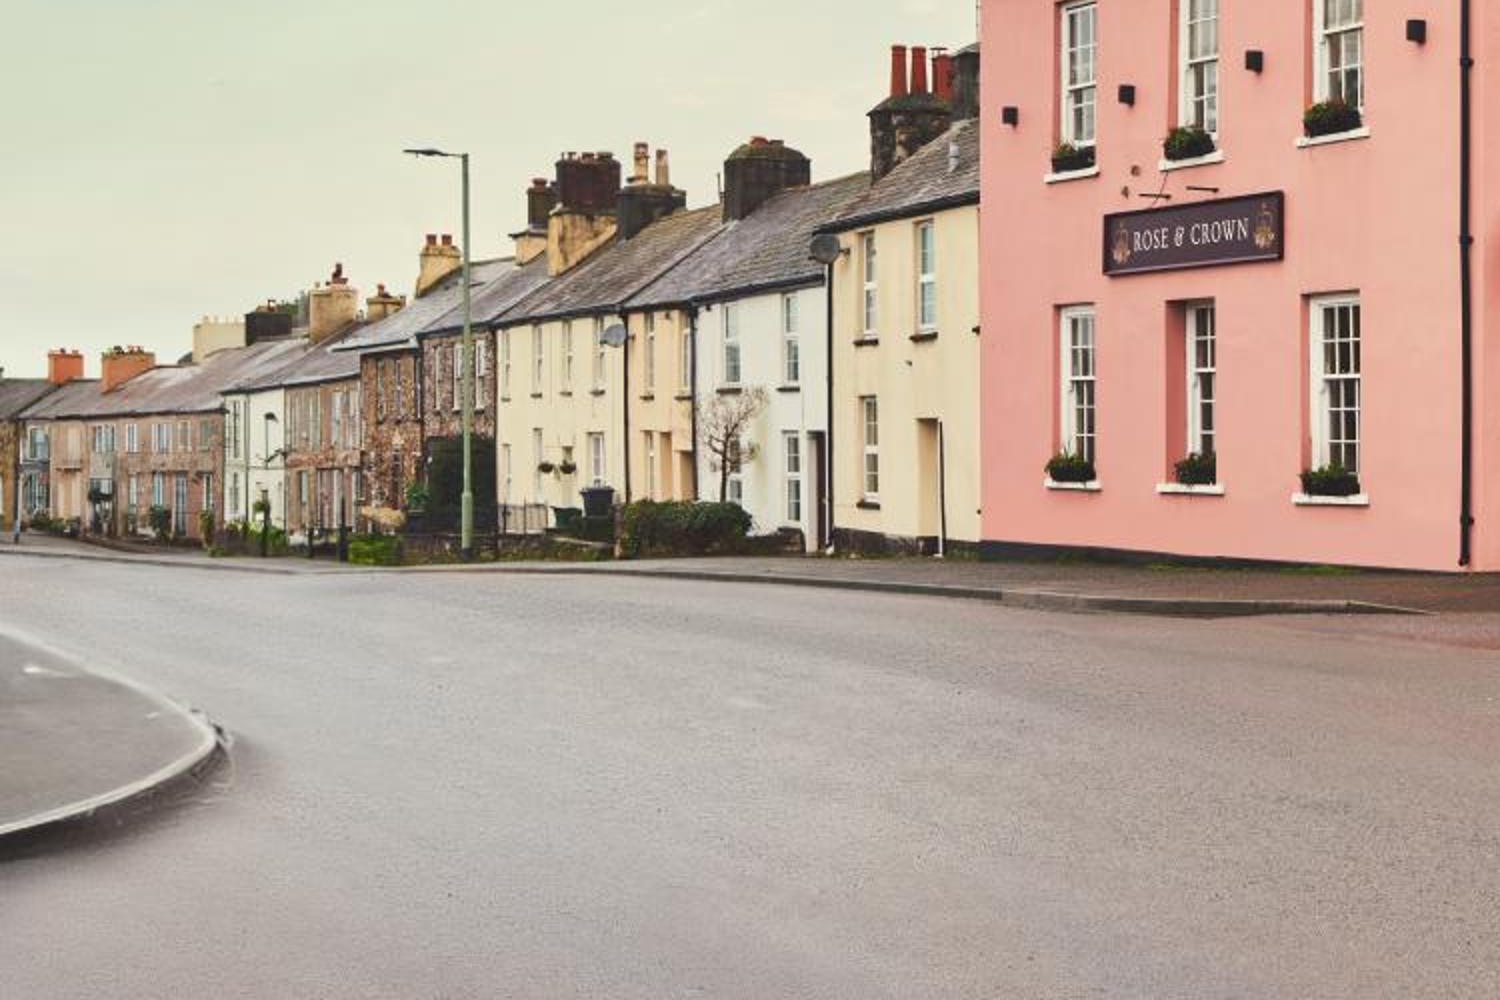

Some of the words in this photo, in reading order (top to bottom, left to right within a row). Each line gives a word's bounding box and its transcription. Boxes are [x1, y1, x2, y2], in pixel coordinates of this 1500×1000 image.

[1133, 227, 1169, 252] ROSE
[1174, 226, 1185, 247] &
[1190, 217, 1249, 246] CROWN
